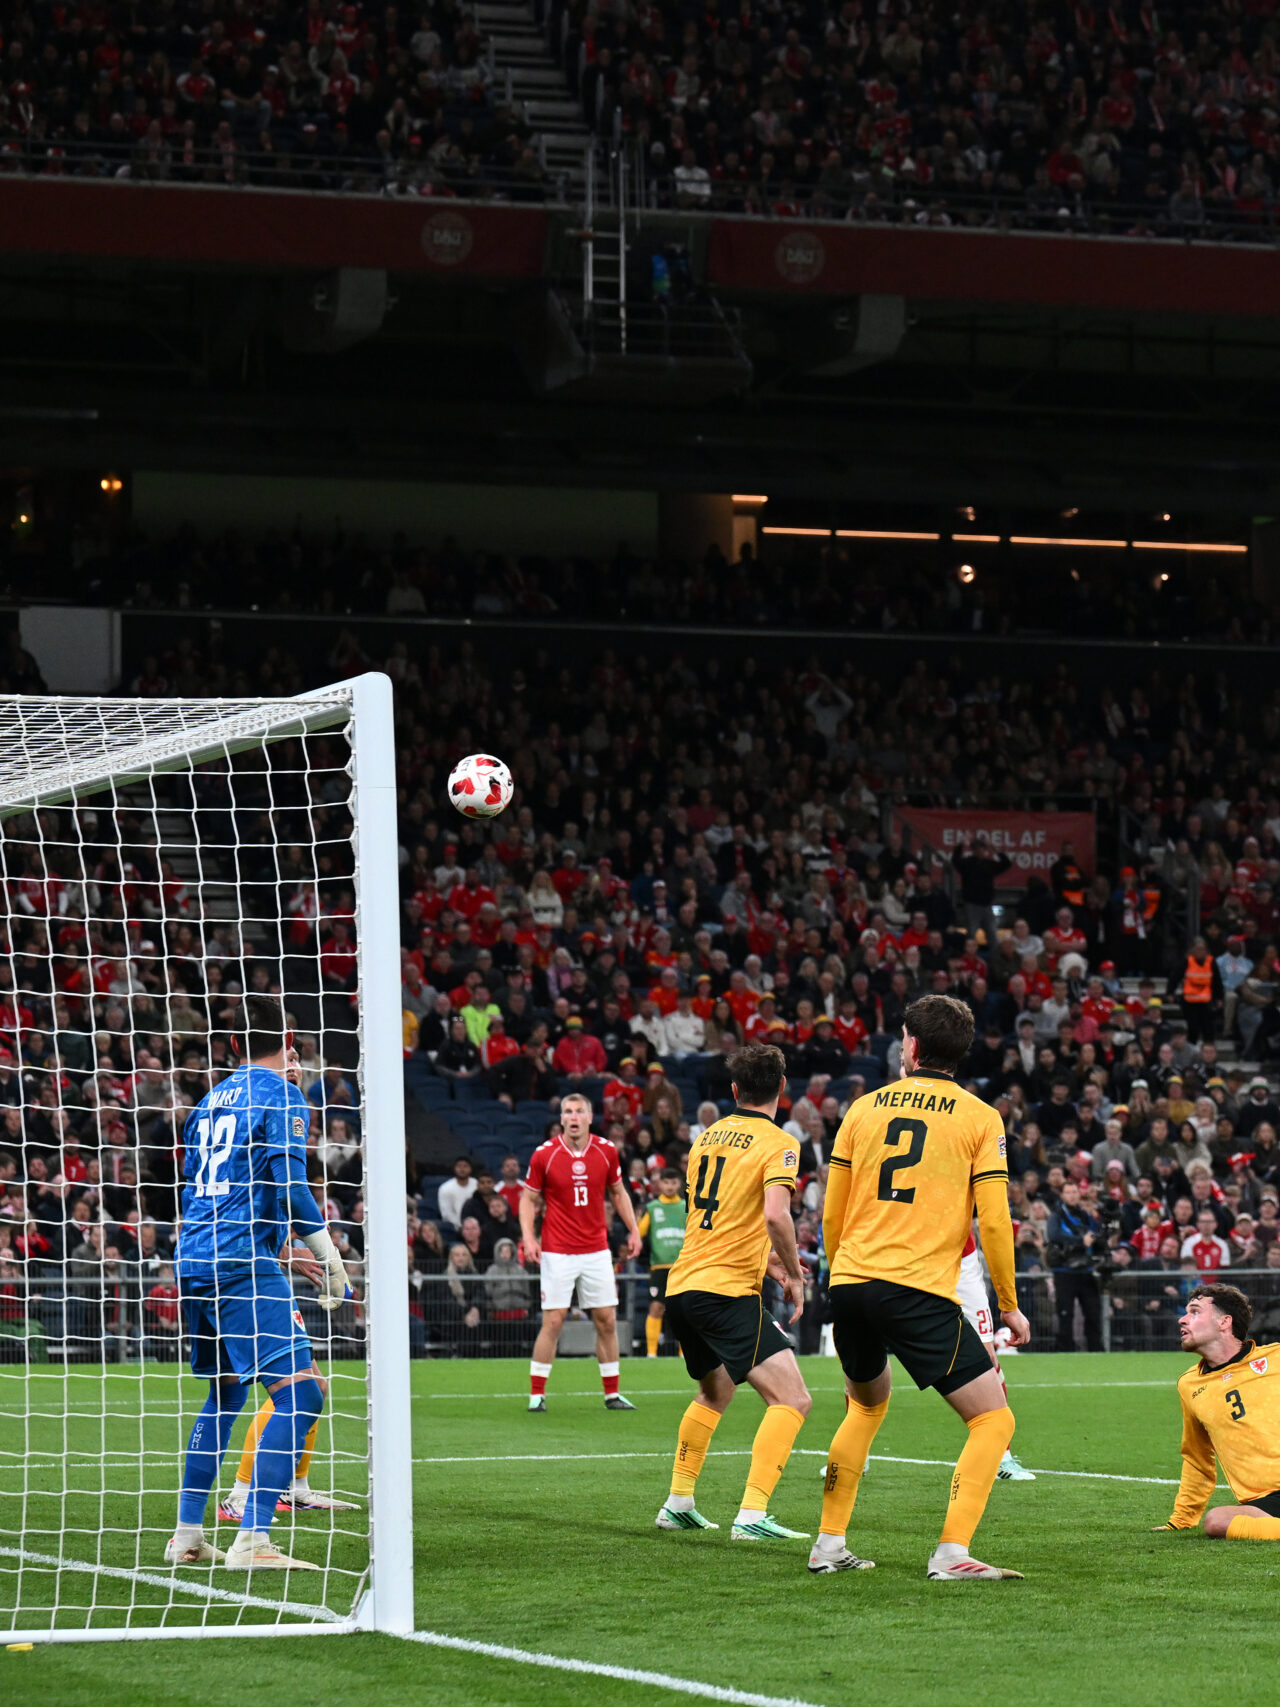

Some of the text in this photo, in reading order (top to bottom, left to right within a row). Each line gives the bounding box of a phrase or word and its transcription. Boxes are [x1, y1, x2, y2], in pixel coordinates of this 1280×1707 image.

[1019, 830, 1047, 847] AF
[873, 1091, 957, 1115] MEPHAM
[700, 1131, 754, 1149] B.DAVIES
[195, 1113, 237, 1197] 12
[877, 1117, 928, 1204] 2
[573, 1186, 588, 1207] 13
[694, 1155, 726, 1230] 4
[1225, 1389, 1246, 1421] 3
[827, 1462, 839, 1492] CYMRU
[950, 1473, 961, 1501] CYMRU
